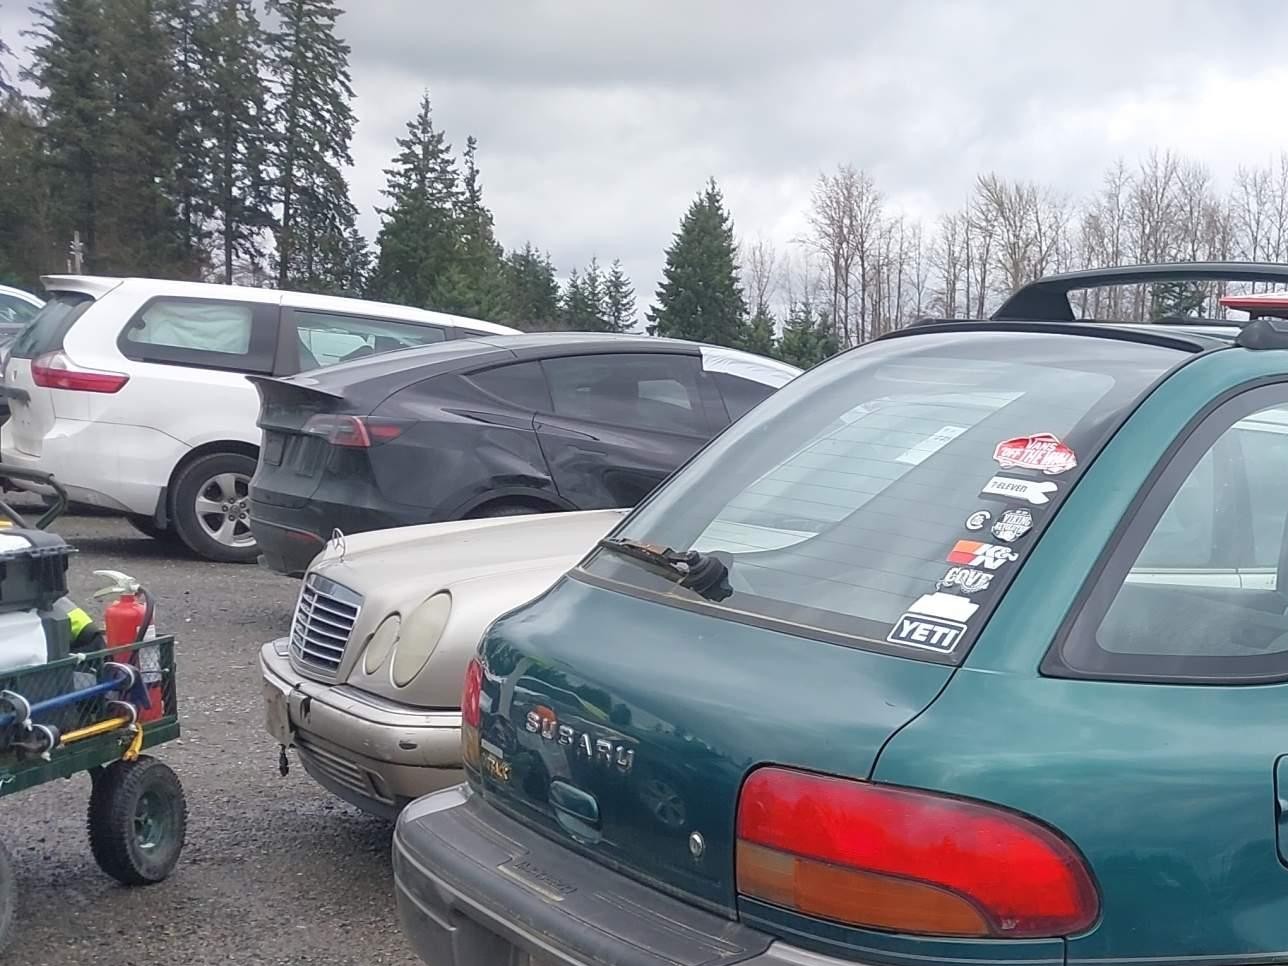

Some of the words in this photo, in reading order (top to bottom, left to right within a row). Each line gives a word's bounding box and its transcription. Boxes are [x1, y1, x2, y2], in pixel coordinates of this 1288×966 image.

[1020, 449, 1047, 465] THE
[899, 619, 959, 647] YETI
[525, 711, 635, 771] SUBARU
